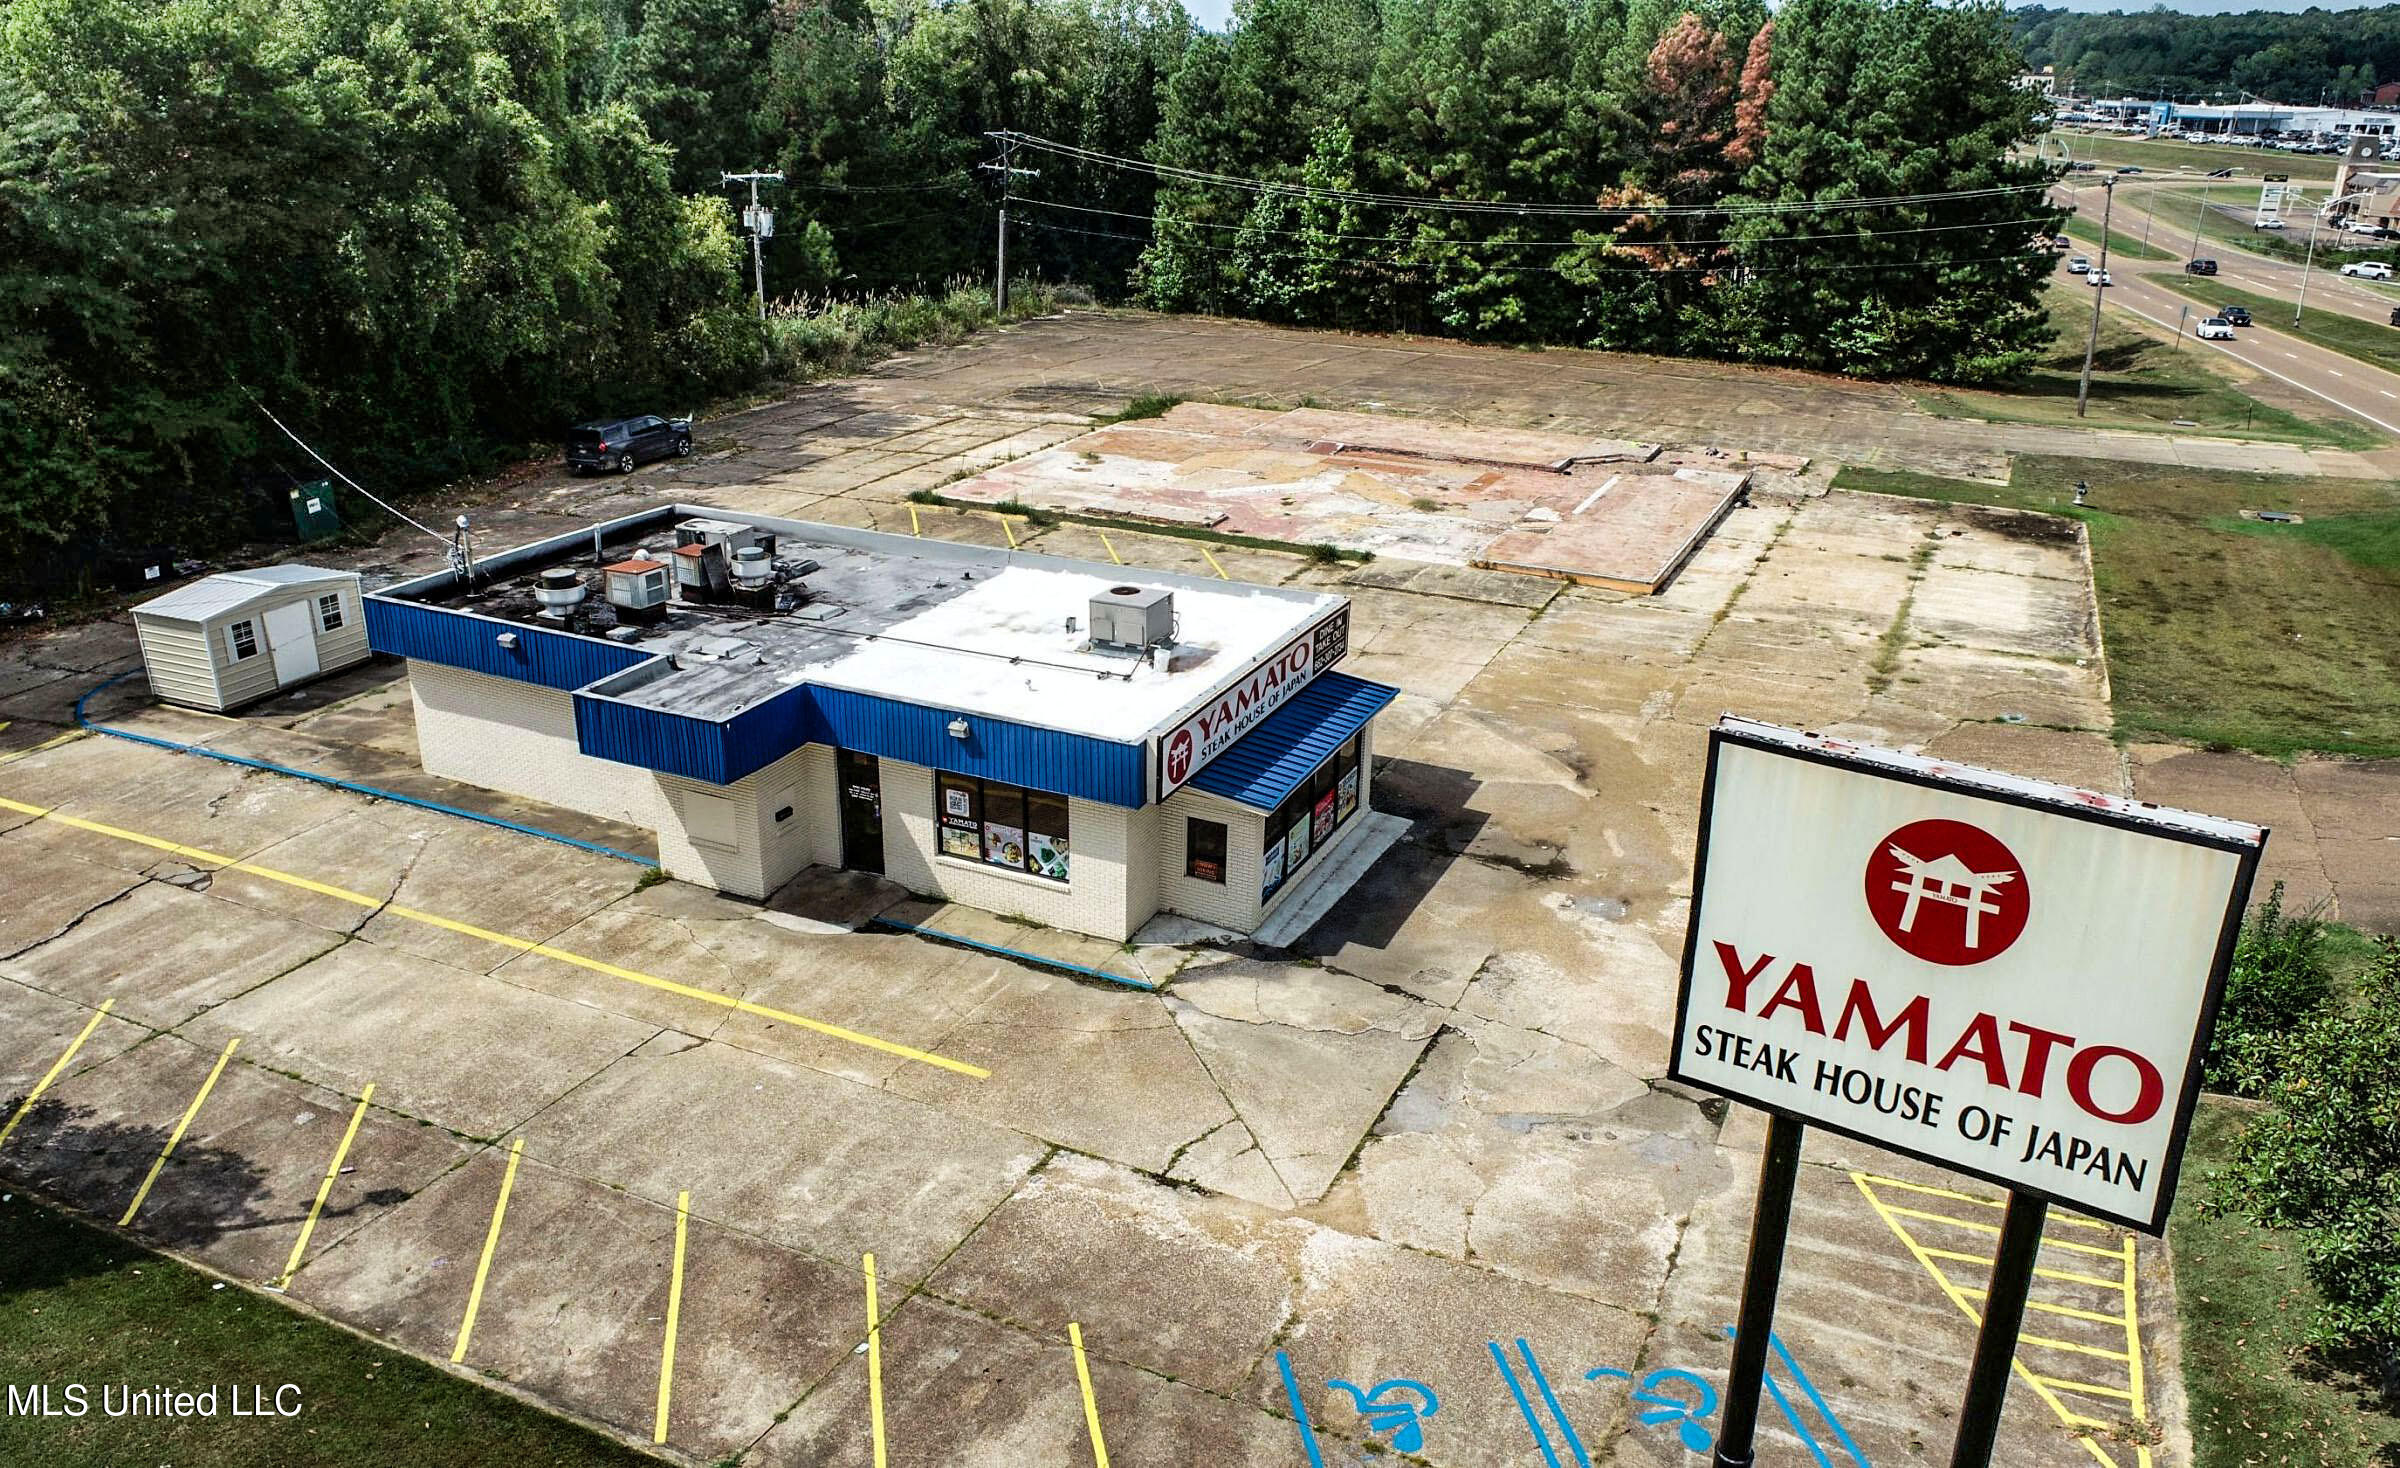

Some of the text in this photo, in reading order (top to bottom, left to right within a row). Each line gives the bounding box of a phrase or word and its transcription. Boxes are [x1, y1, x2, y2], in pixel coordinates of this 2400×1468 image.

[1315, 625, 1346, 653] TAKE OUT
[1320, 621, 1334, 640] DINE
[1198, 642, 1310, 742] YAMATO
[1201, 670, 1307, 761] STEAK HOUSE OF JAPAN
[1711, 939, 2164, 1125] YAMATO
[1696, 1024, 2148, 1192] STEAK HOUSE OF JAPAN
